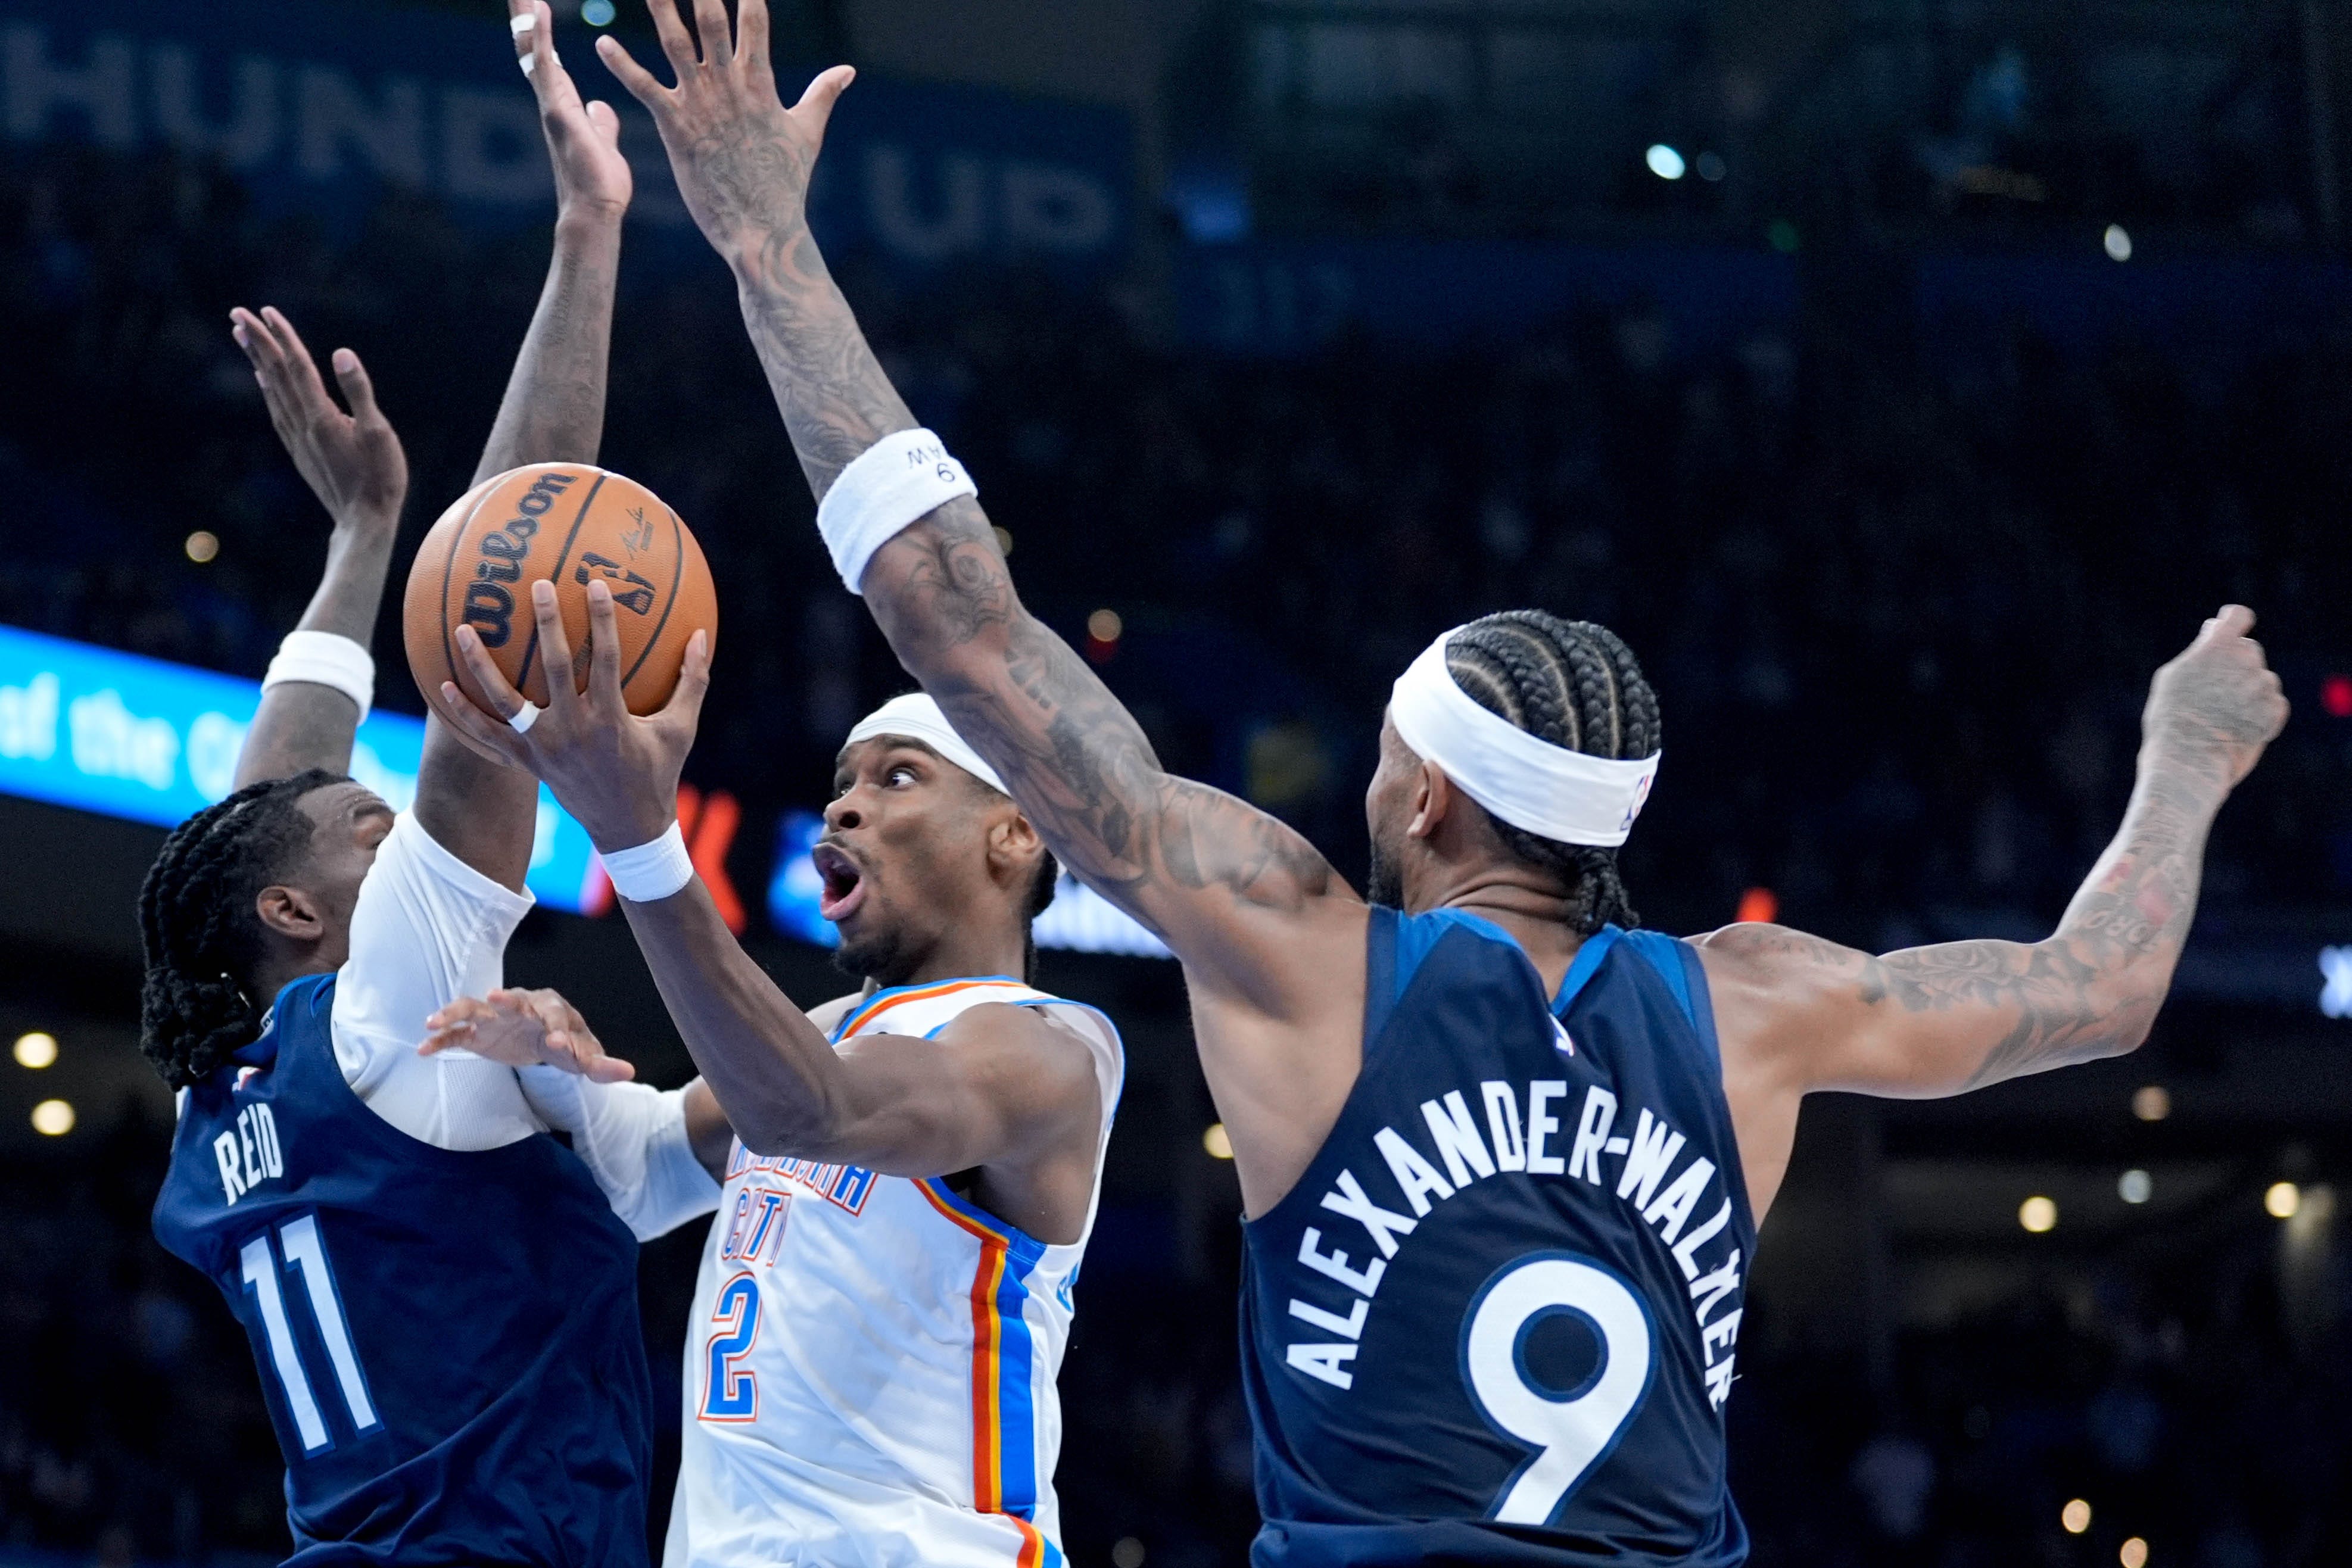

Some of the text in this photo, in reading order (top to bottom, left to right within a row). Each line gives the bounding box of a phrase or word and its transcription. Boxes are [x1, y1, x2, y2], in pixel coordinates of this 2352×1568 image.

[862, 145, 1121, 260] UP
[462, 472, 578, 648] Wilson
[69, 688, 180, 791] the
[213, 1103, 283, 1206] REID
[1286, 1080, 1743, 1411] ALEXANDER-WALKER
[240, 1214, 377, 1451] 11
[697, 1271, 762, 1423] 2
[1467, 1258, 1650, 1526] 9
